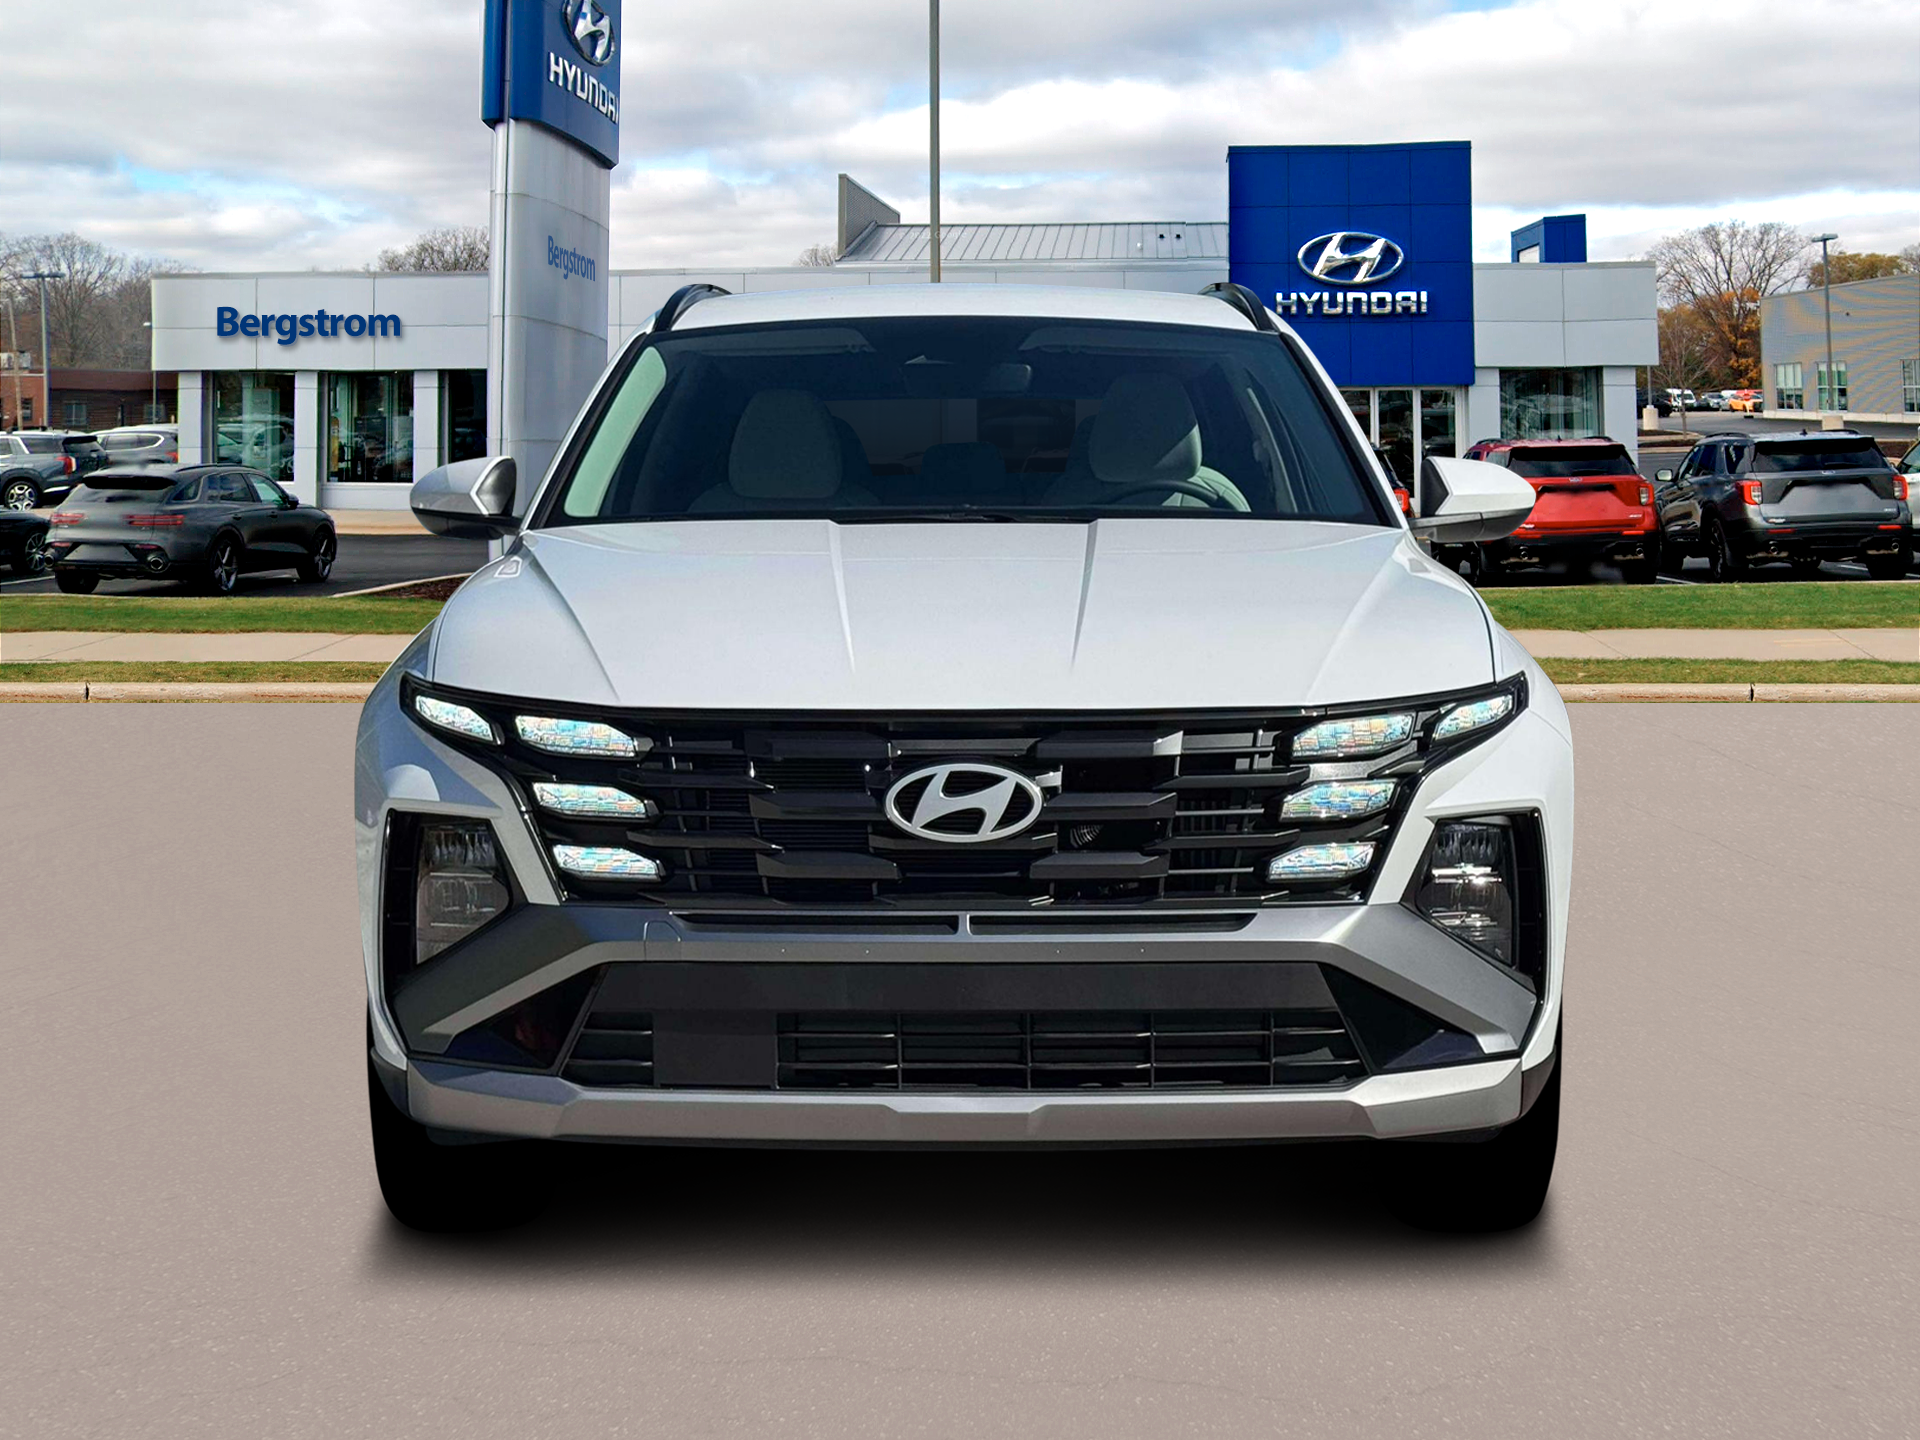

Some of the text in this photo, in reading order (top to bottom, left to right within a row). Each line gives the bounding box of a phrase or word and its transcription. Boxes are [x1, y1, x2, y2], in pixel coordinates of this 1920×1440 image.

[549, 51, 619, 124] HYUNDAI
[547, 235, 596, 281] Bergstrom
[1275, 291, 1428, 315] HYUNDAI
[216, 306, 402, 346] Bergstrom
